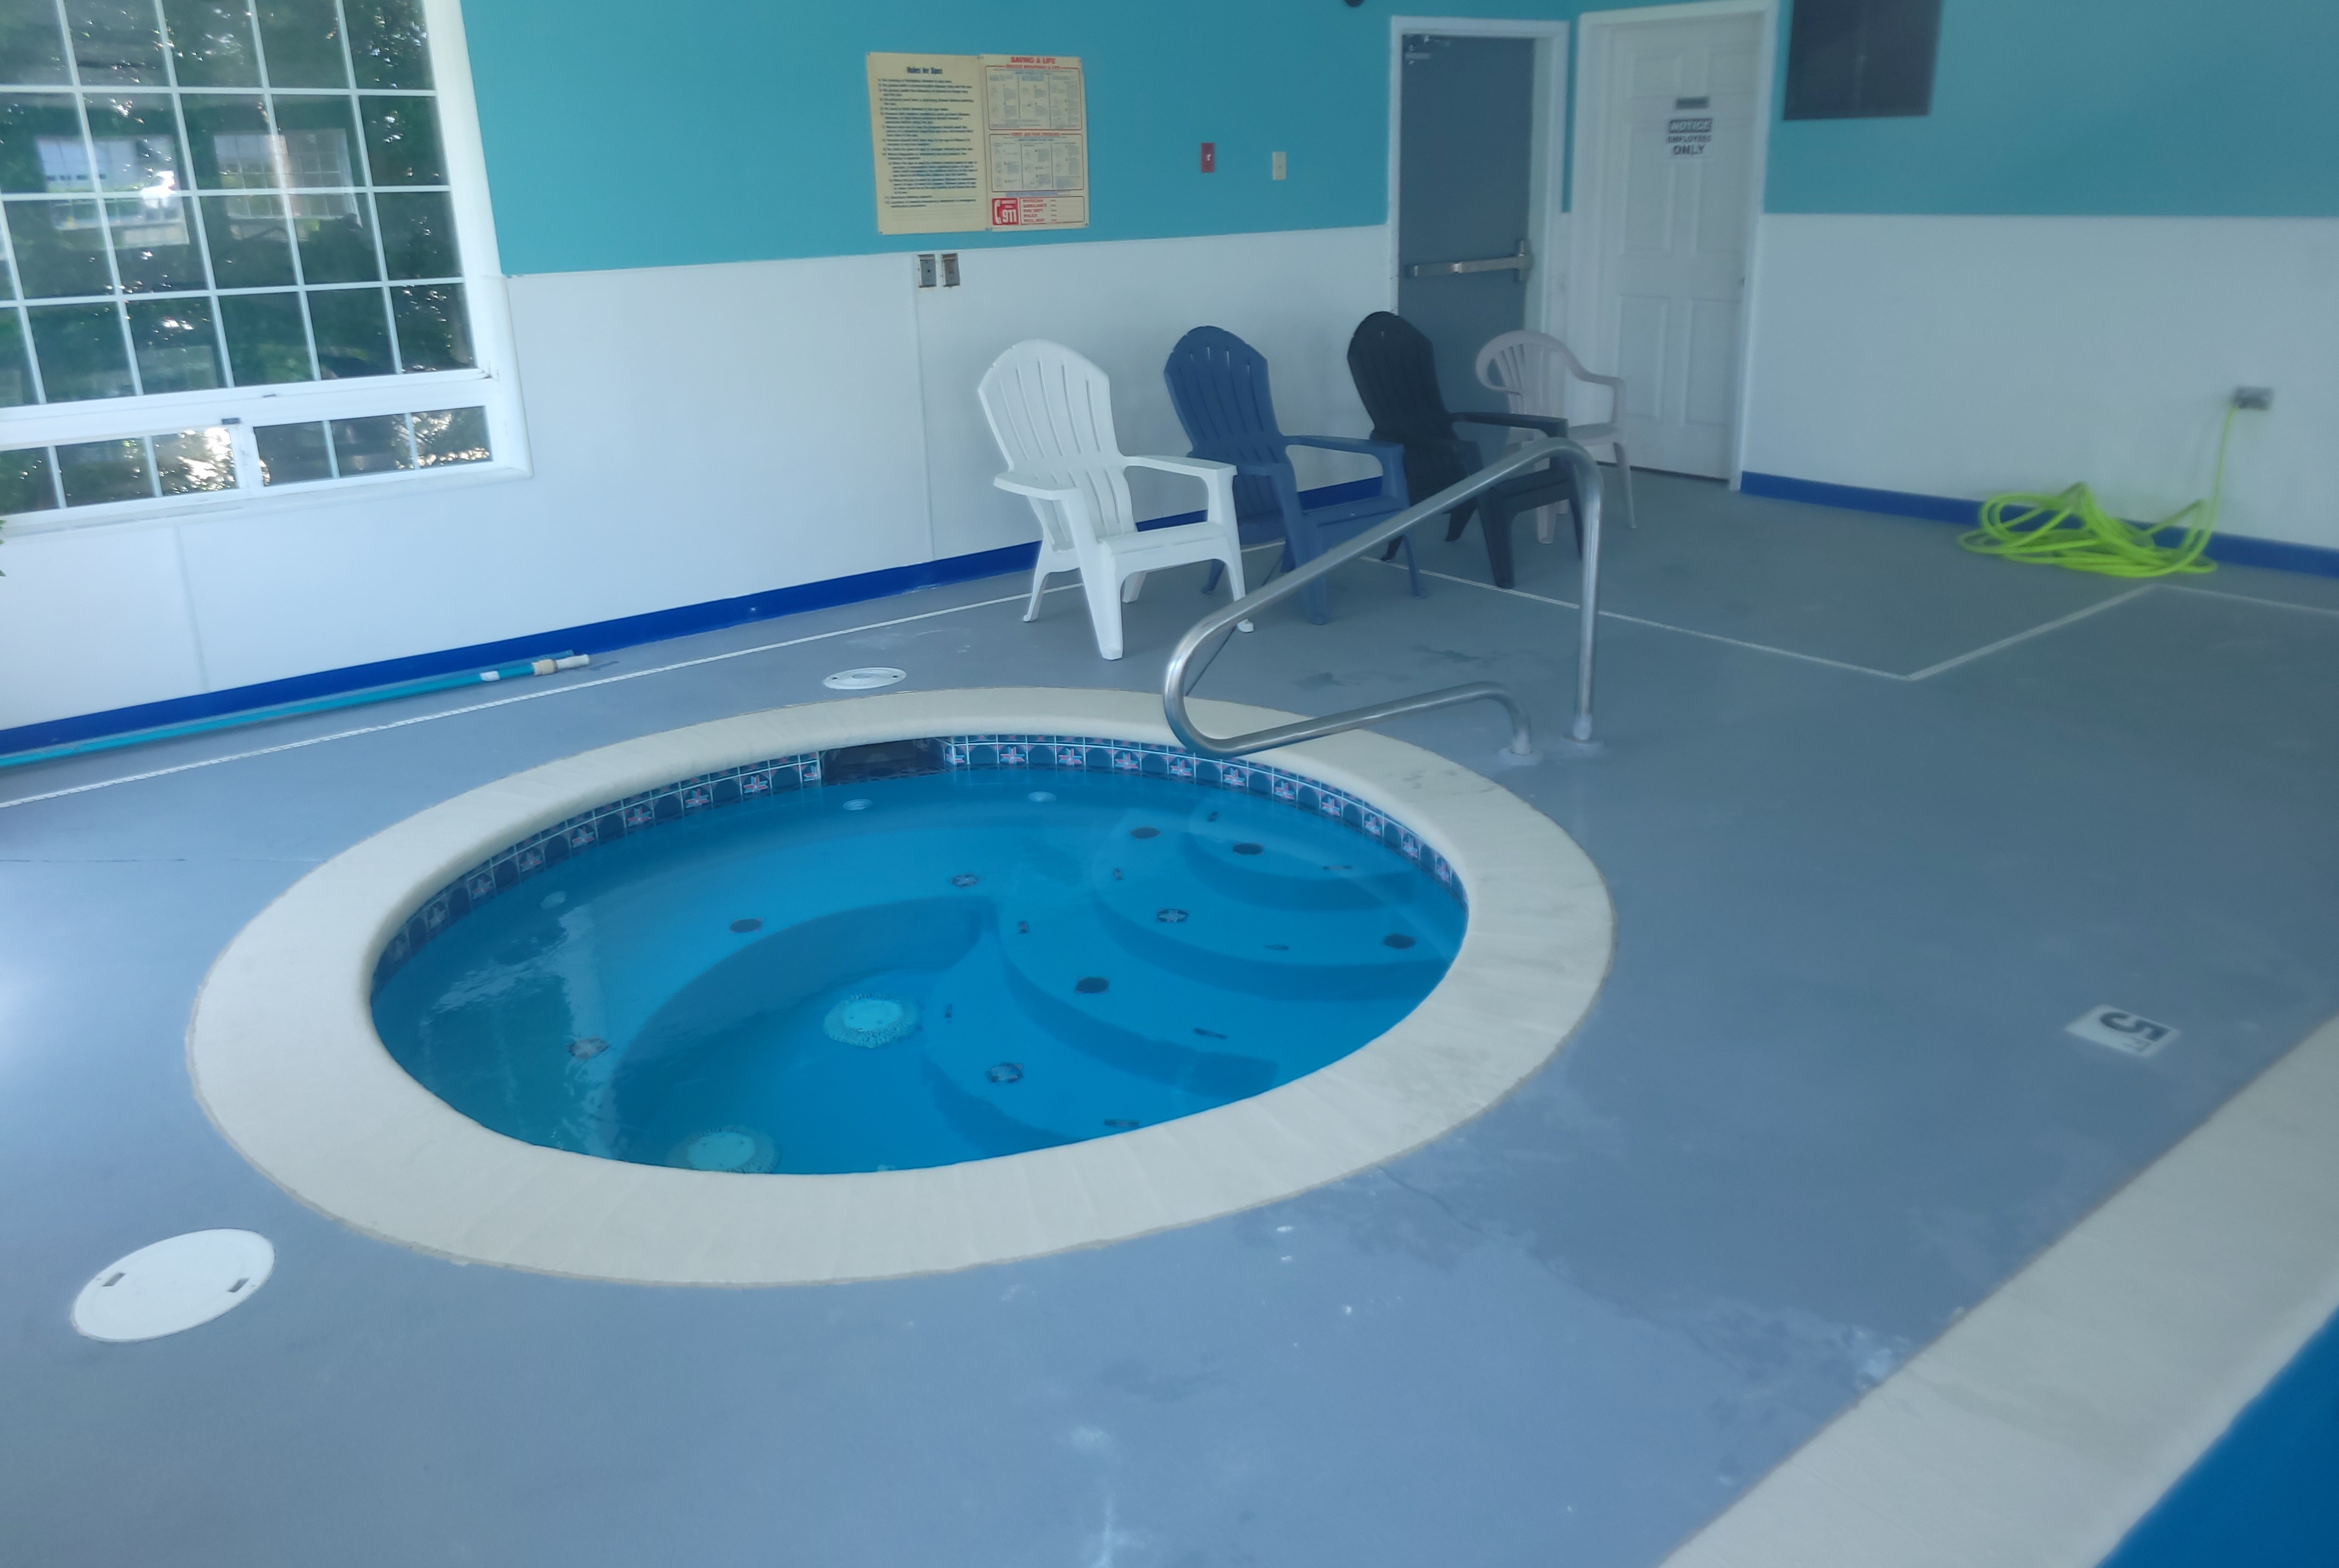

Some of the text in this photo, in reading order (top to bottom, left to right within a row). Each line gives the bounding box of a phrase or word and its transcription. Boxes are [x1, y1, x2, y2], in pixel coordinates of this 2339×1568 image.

[1671, 121, 1711, 131] NOTICE
[1673, 144, 1705, 155] ONLY
[1002, 209, 1016, 222] 911
[2100, 1011, 2171, 1041] 5
